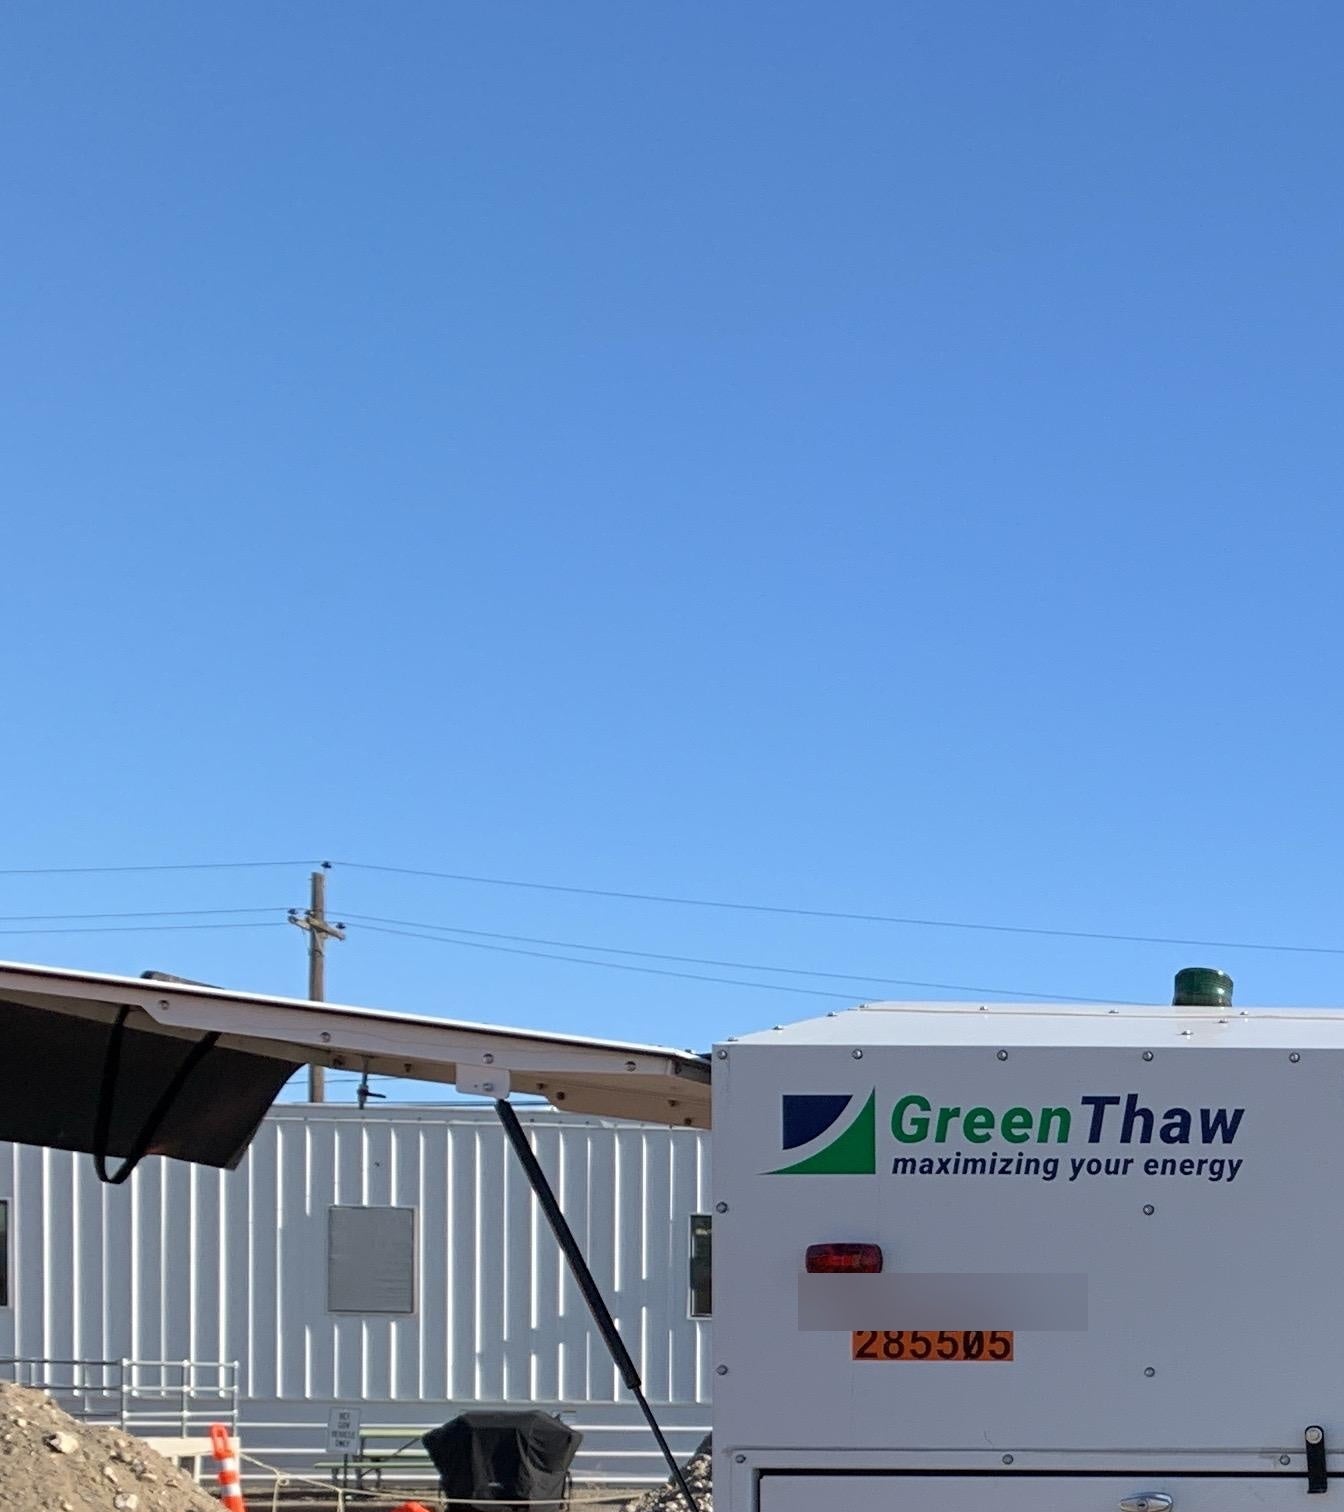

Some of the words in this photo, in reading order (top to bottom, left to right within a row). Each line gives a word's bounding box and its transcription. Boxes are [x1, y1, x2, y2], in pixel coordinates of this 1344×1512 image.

[891, 1152, 1059, 1181] maximizing
[1069, 1157, 1134, 1182] your
[1144, 1157, 1243, 1182] energy
[856, 1331, 1011, 1360] 285505
